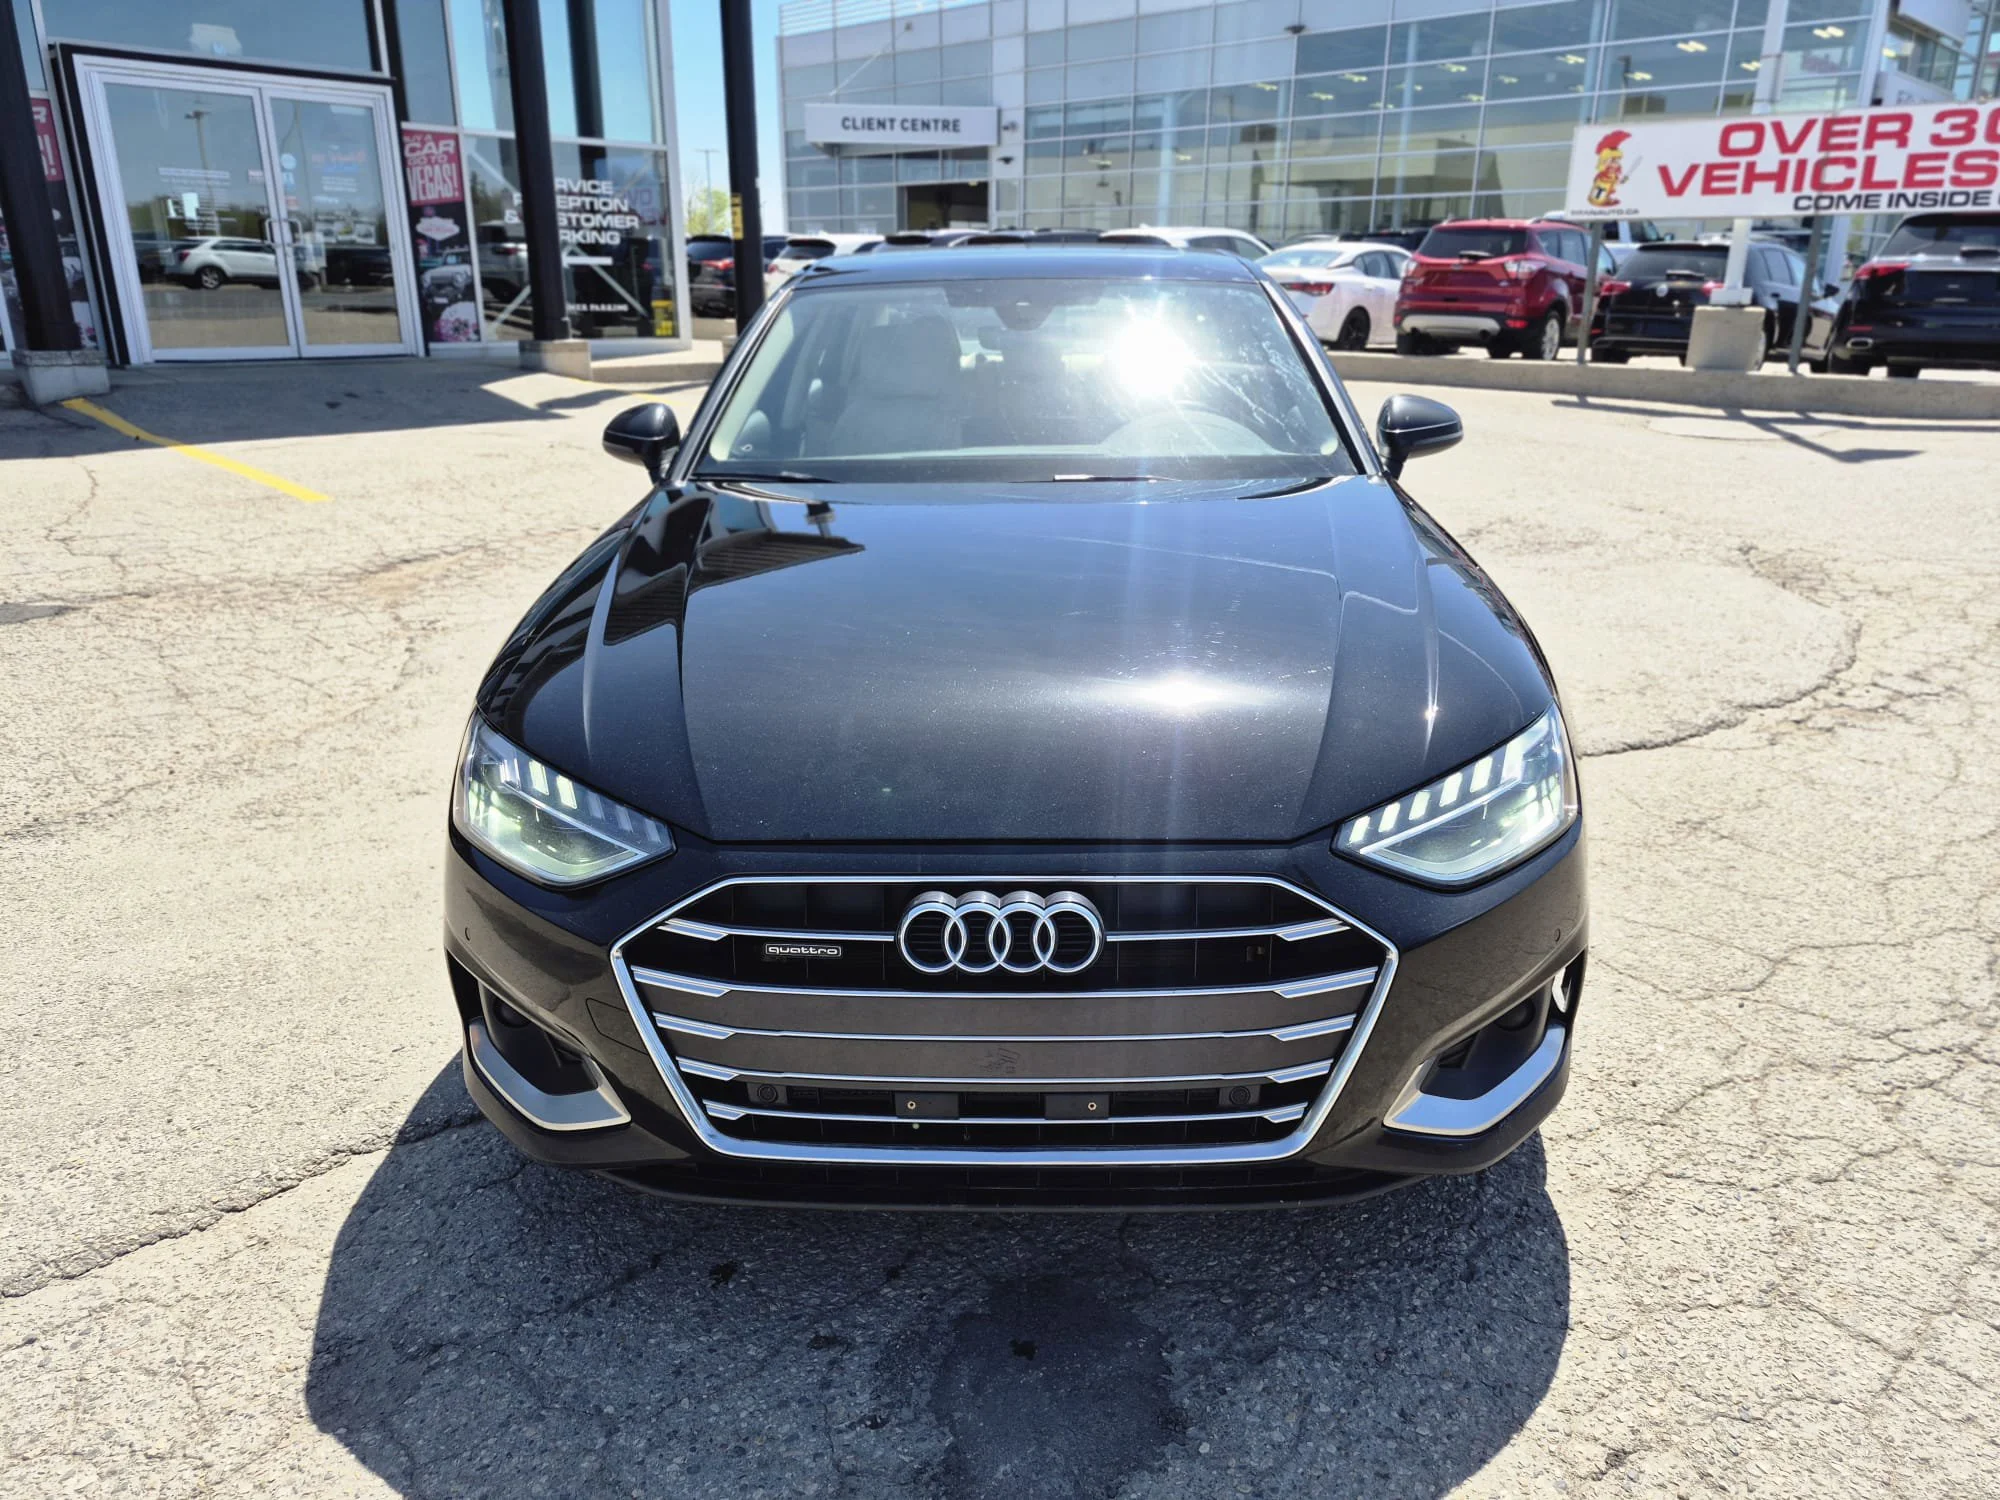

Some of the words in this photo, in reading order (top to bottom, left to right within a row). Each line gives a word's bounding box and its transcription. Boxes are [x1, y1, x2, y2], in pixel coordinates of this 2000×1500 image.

[841, 116, 897, 131] CLIENT
[900, 117, 962, 133] CENTRE
[1718, 113, 1913, 158] OVER
[1929, 106, 2000, 147] 3
[404, 140, 456, 157] CAR
[1657, 150, 2000, 197] VEHICLES
[406, 163, 459, 203] VEGAS!
[555, 178, 614, 195] RVICE
[1793, 193, 1882, 211] COME
[1887, 190, 1993, 209] INSIDE
[558, 213, 640, 229] STOMER
[559, 229, 621, 245] RKING
[768, 946, 838, 955] quattro
